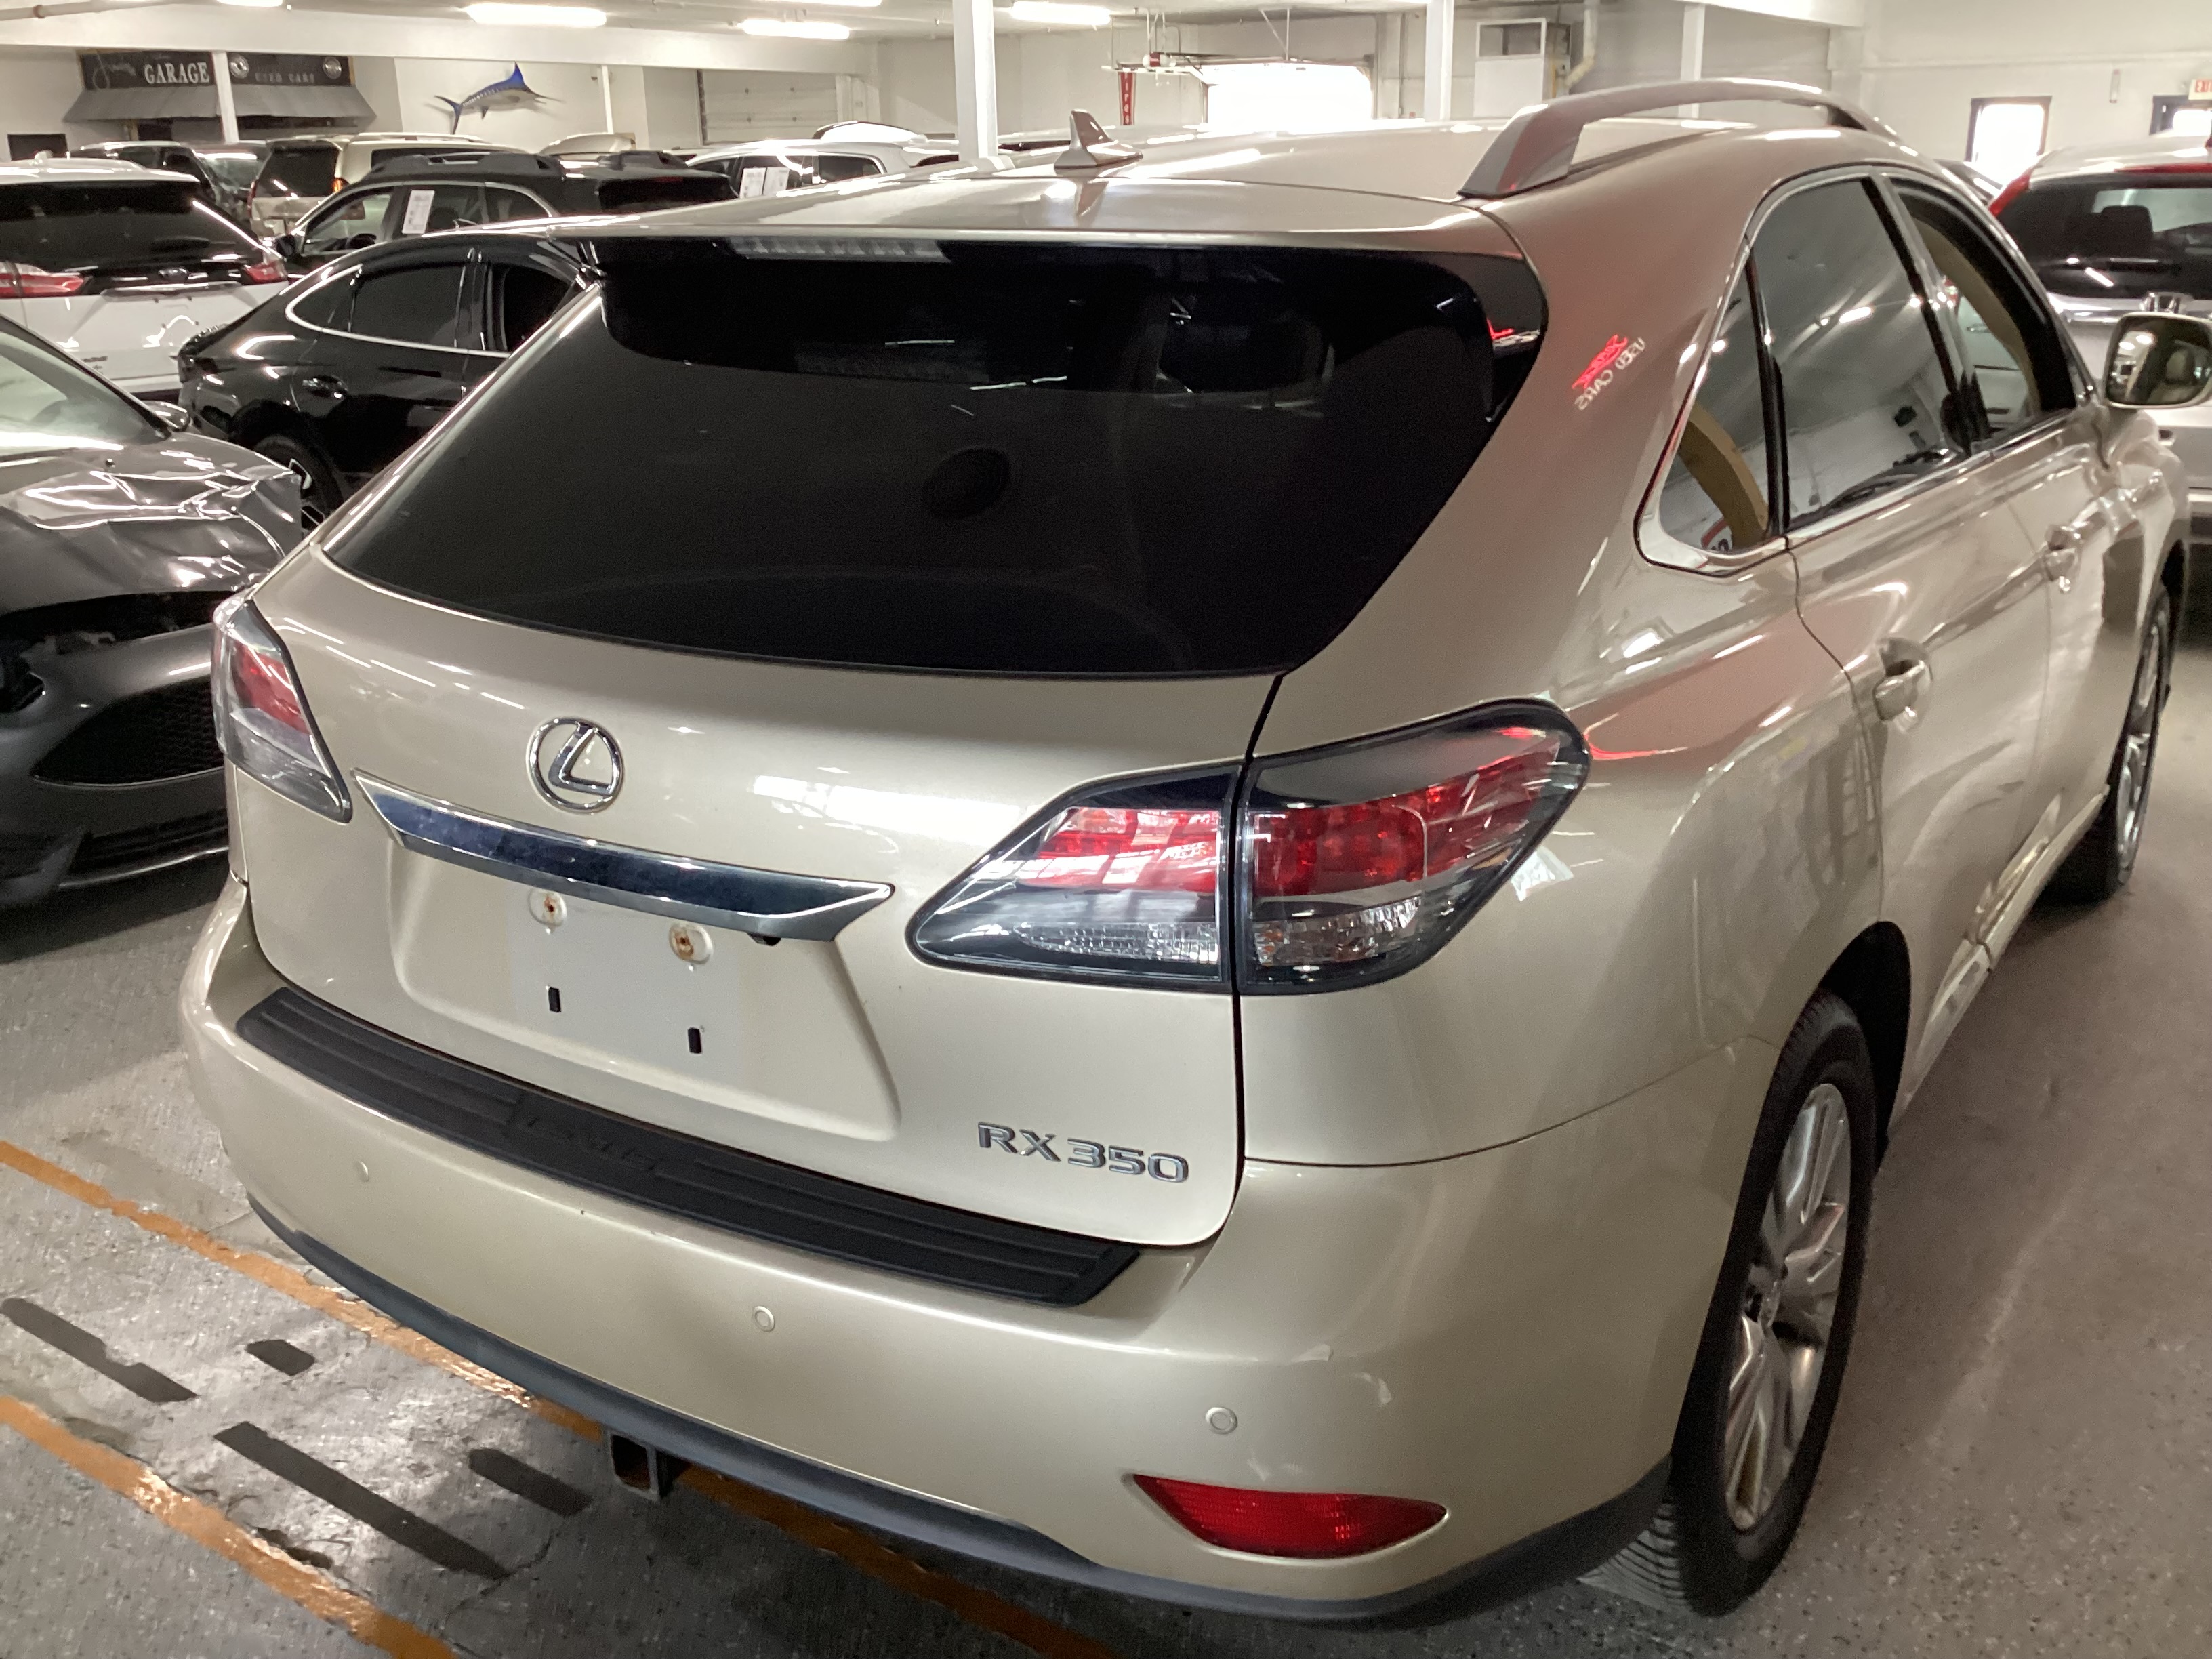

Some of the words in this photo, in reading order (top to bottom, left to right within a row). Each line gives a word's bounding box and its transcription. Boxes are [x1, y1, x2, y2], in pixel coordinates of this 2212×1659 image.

[144, 62, 210, 84] GARAGE
[977, 1121, 1061, 1162] RX
[1067, 1137, 1189, 1183] 350
